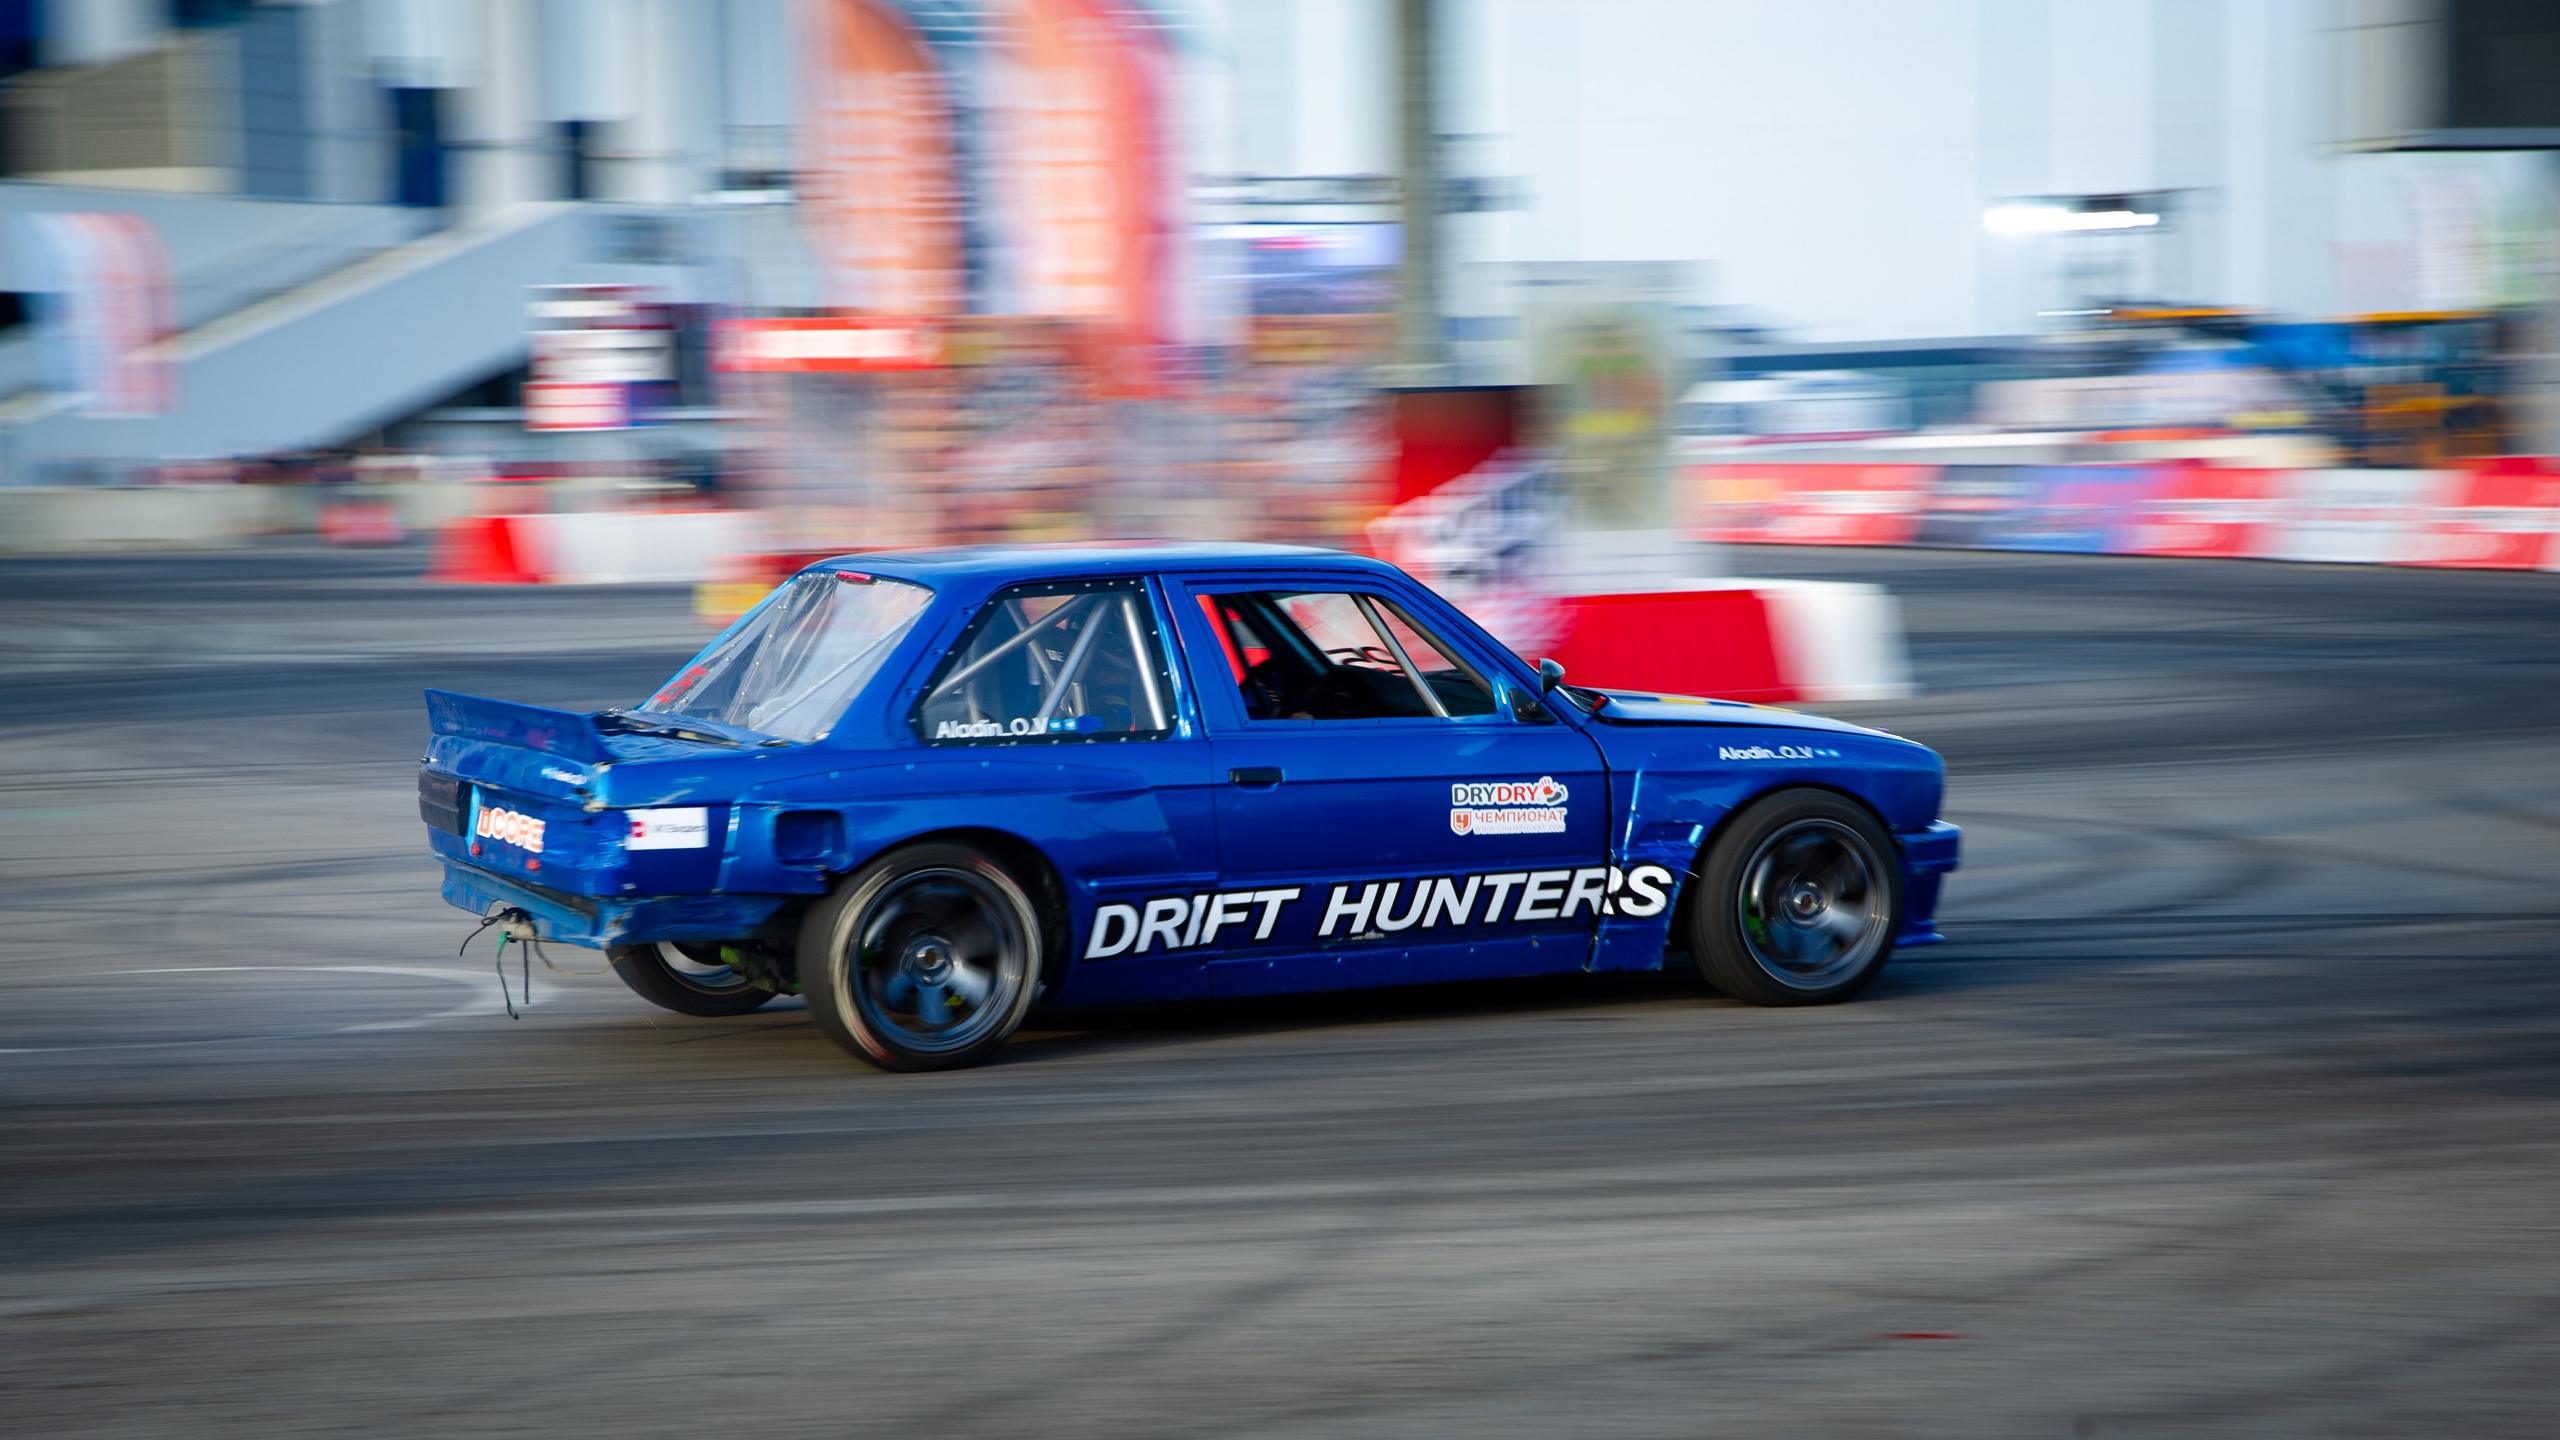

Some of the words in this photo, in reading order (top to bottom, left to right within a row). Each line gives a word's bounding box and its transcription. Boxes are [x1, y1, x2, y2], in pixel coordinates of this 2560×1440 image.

[1453, 785, 1538, 803] DRYDRY
[1475, 810, 1565, 823] ЧЕМПИОНАТ
[1083, 887, 1300, 960] DRIFT
[1316, 865, 1673, 938] HUNTERS
